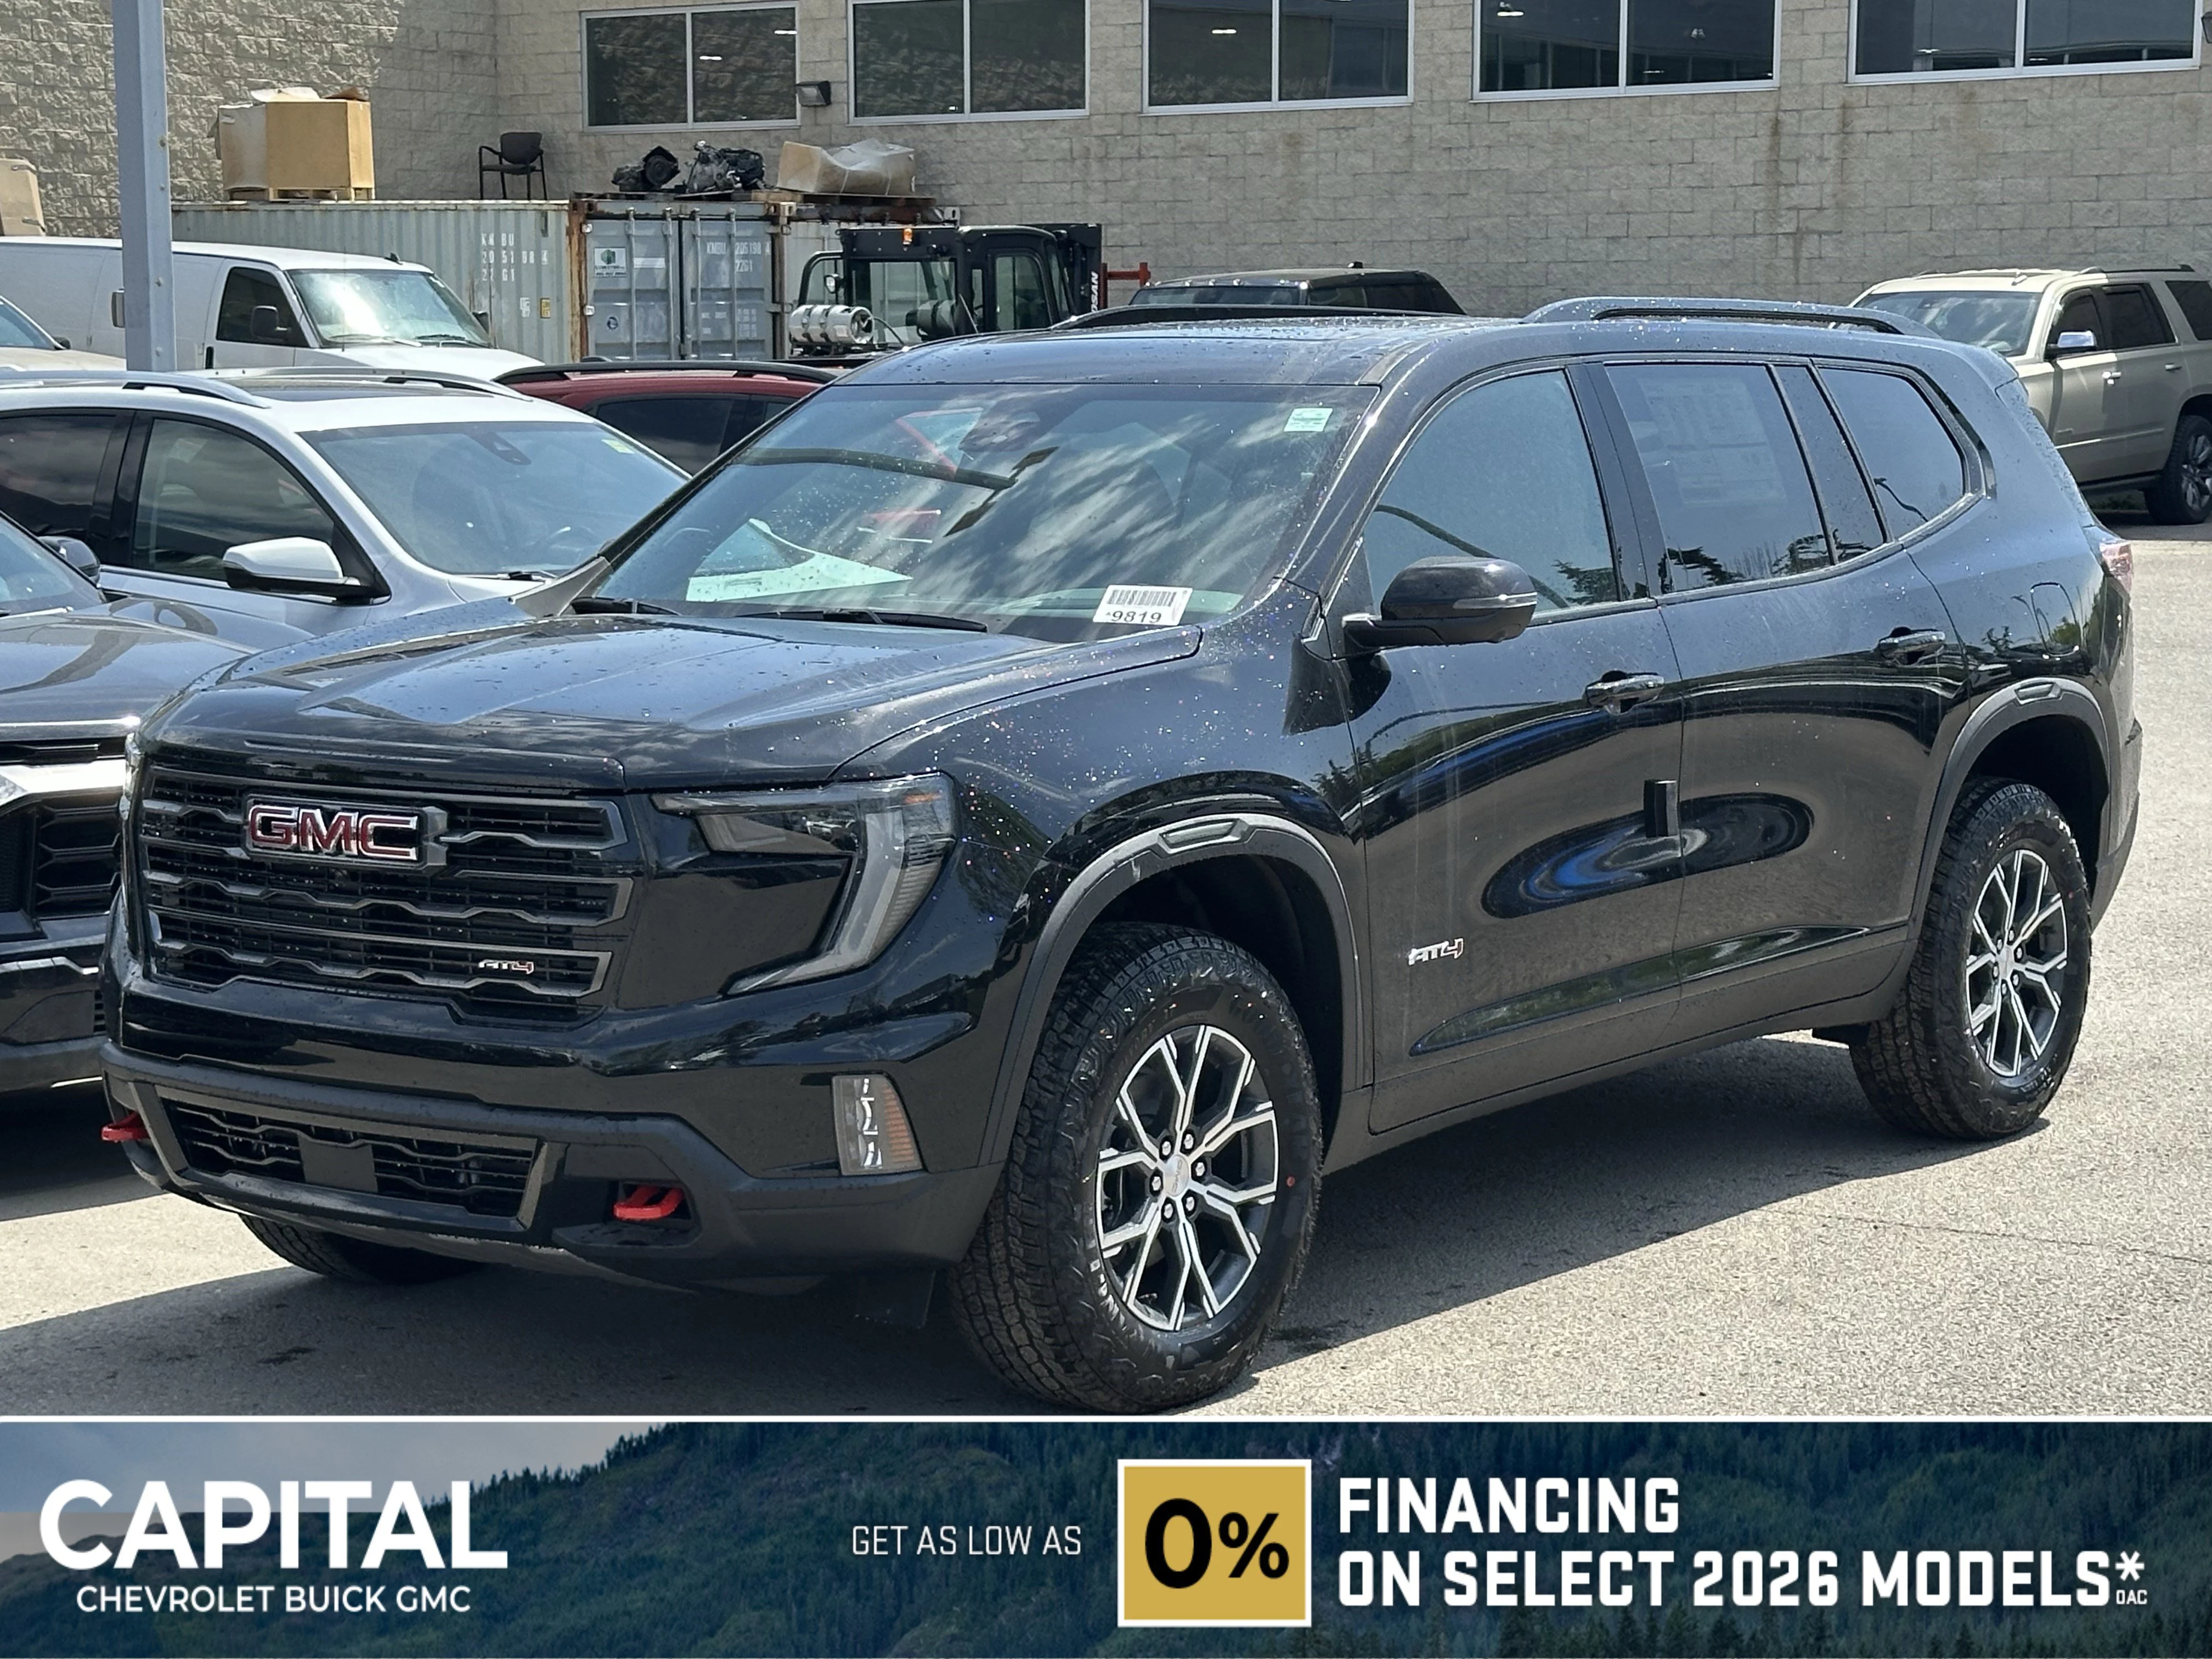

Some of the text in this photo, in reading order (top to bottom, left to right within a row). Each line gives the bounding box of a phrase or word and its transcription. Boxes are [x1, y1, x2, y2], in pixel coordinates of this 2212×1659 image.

[1111, 611, 1161, 624] 9819
[249, 804, 417, 860] GMC
[1408, 938, 1464, 966] AT4
[478, 959, 534, 974] AT4
